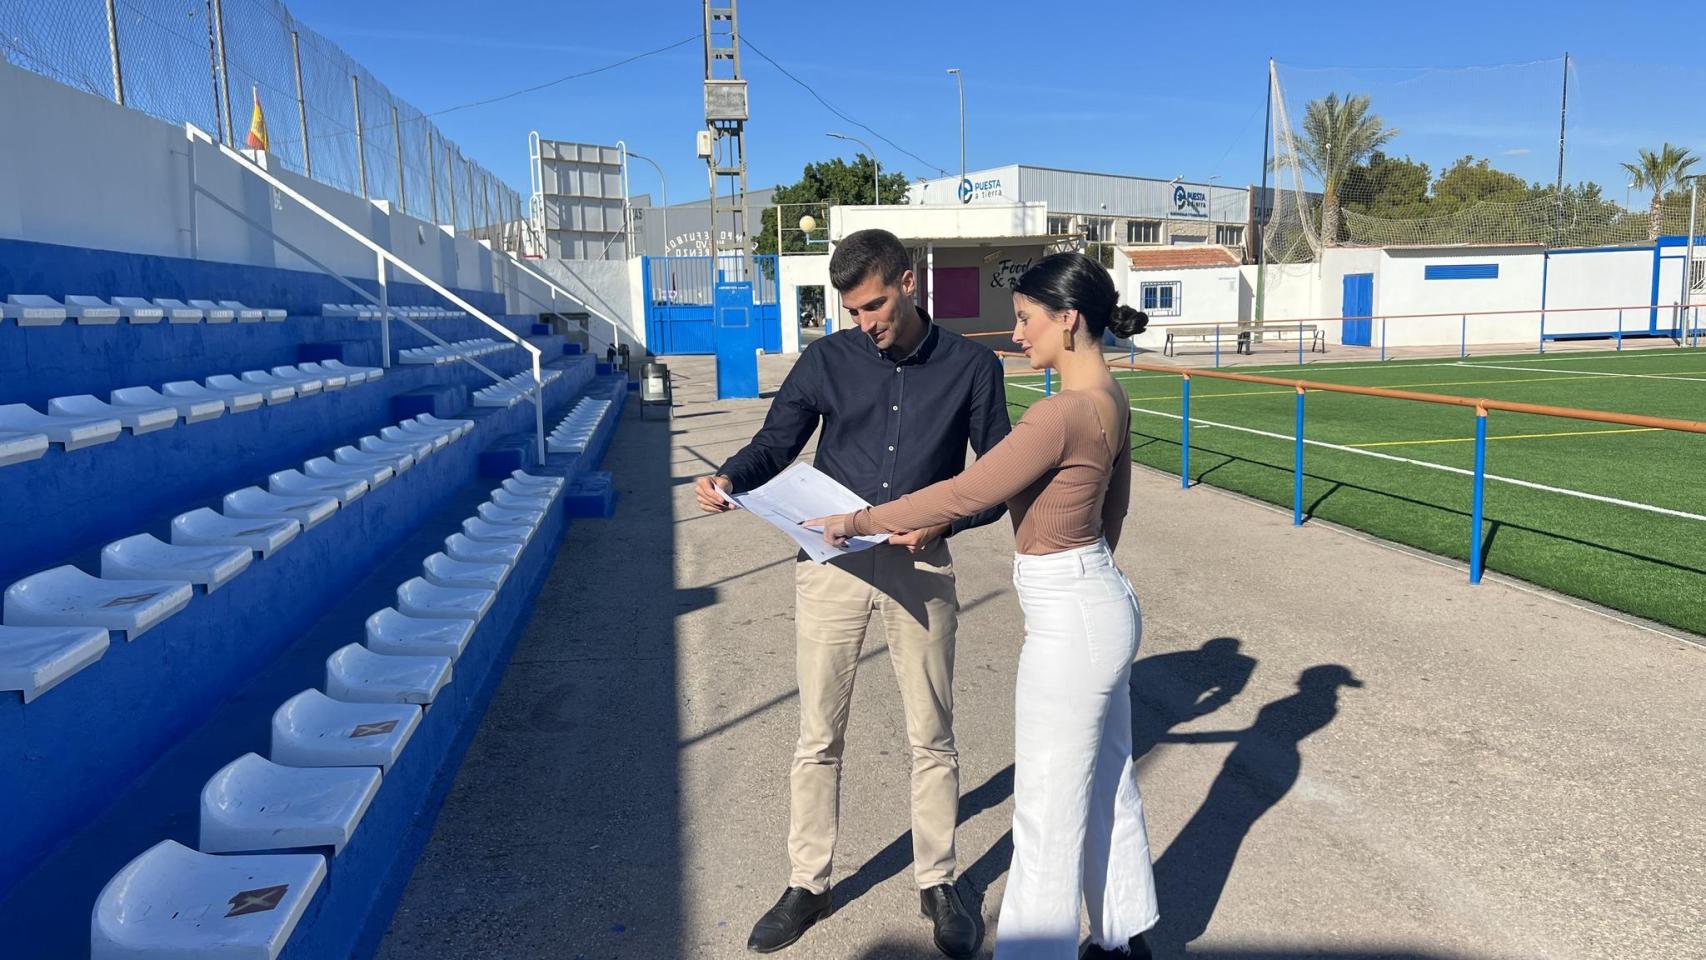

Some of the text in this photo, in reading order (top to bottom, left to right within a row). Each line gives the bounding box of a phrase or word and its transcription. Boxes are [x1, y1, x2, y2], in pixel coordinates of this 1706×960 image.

[975, 179, 1001, 191] PUESTA
[982, 190, 1002, 199] tierra
[998, 257, 1032, 274] Food
[991, 272, 1004, 288] &
